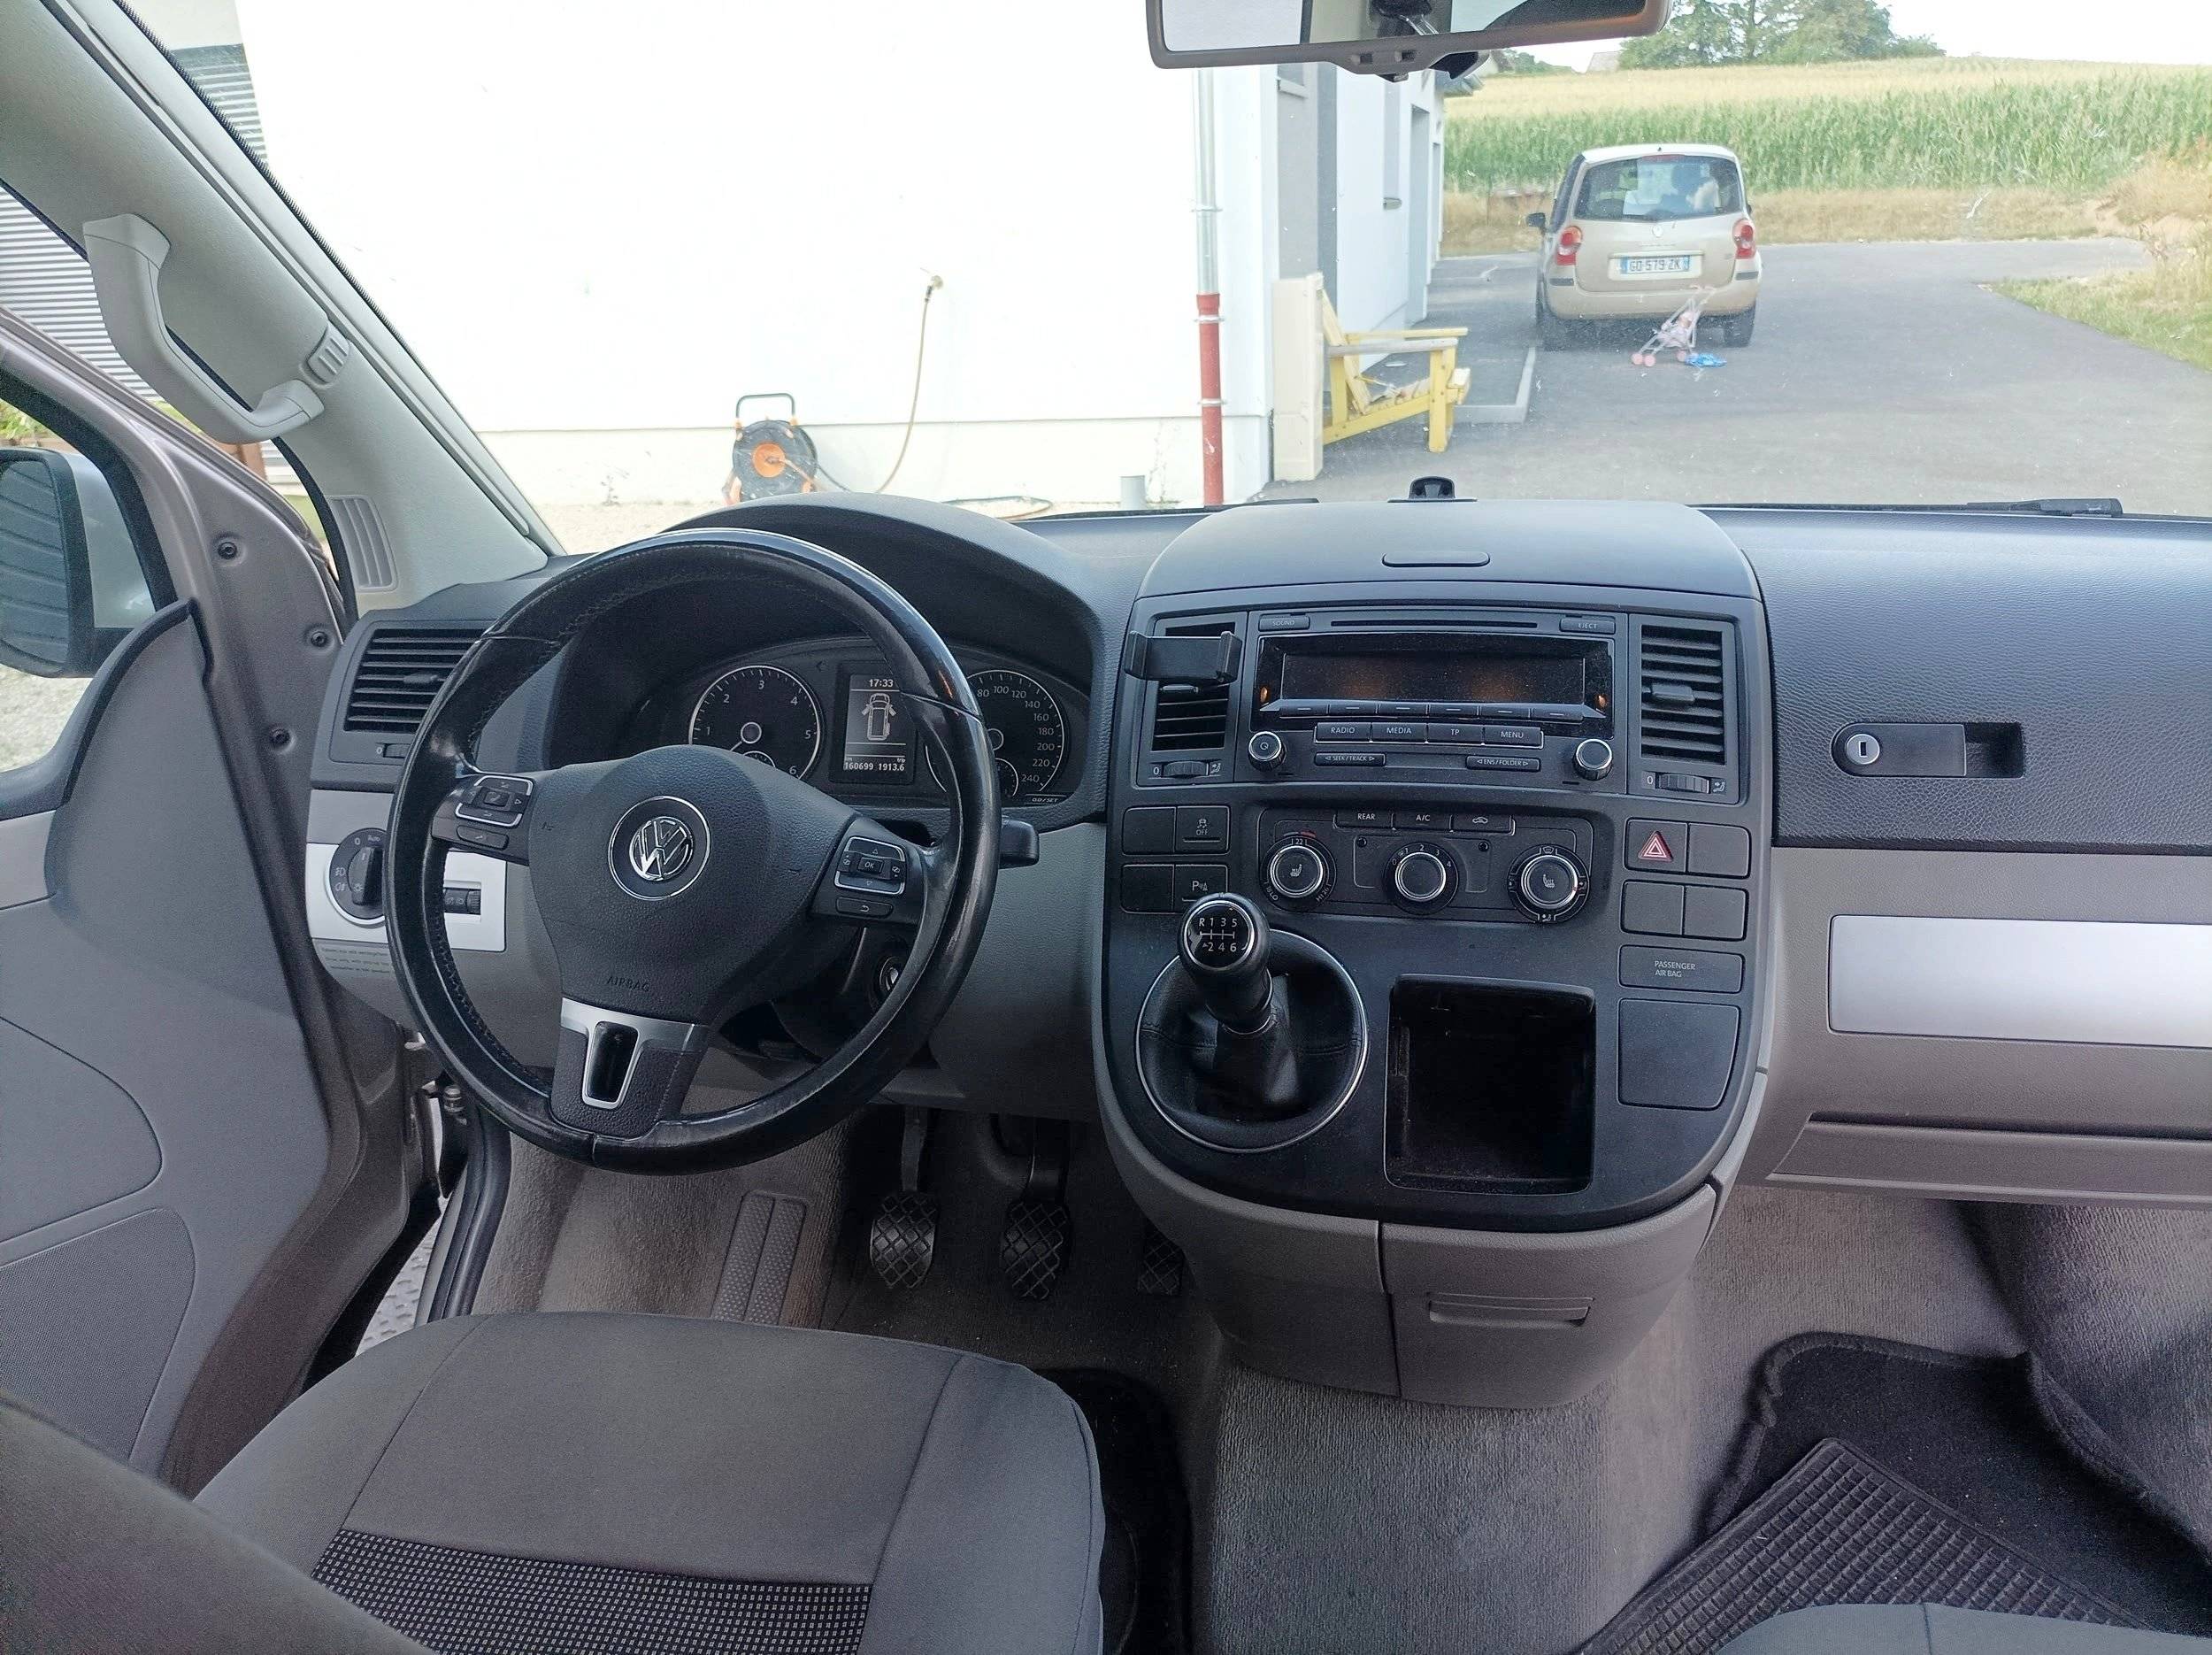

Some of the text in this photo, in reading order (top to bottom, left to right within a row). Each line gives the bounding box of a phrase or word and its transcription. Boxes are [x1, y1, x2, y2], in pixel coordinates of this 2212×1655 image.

[759, 680, 765, 689] 3
[869, 679, 894, 688] 17:33
[724, 694, 730, 703] 2
[1012, 690, 1026, 699] 120
[791, 697, 798, 705] 4
[707, 727, 710, 735] 1
[805, 730, 811, 739] 5
[1032, 759, 1050, 767] 220
[789, 766, 796, 775] 6
[1199, 918, 1238, 927] R 1 3 5
[1208, 942, 1237, 952] 2 4 6
[1654, 960, 1696, 971] PASSENGER
